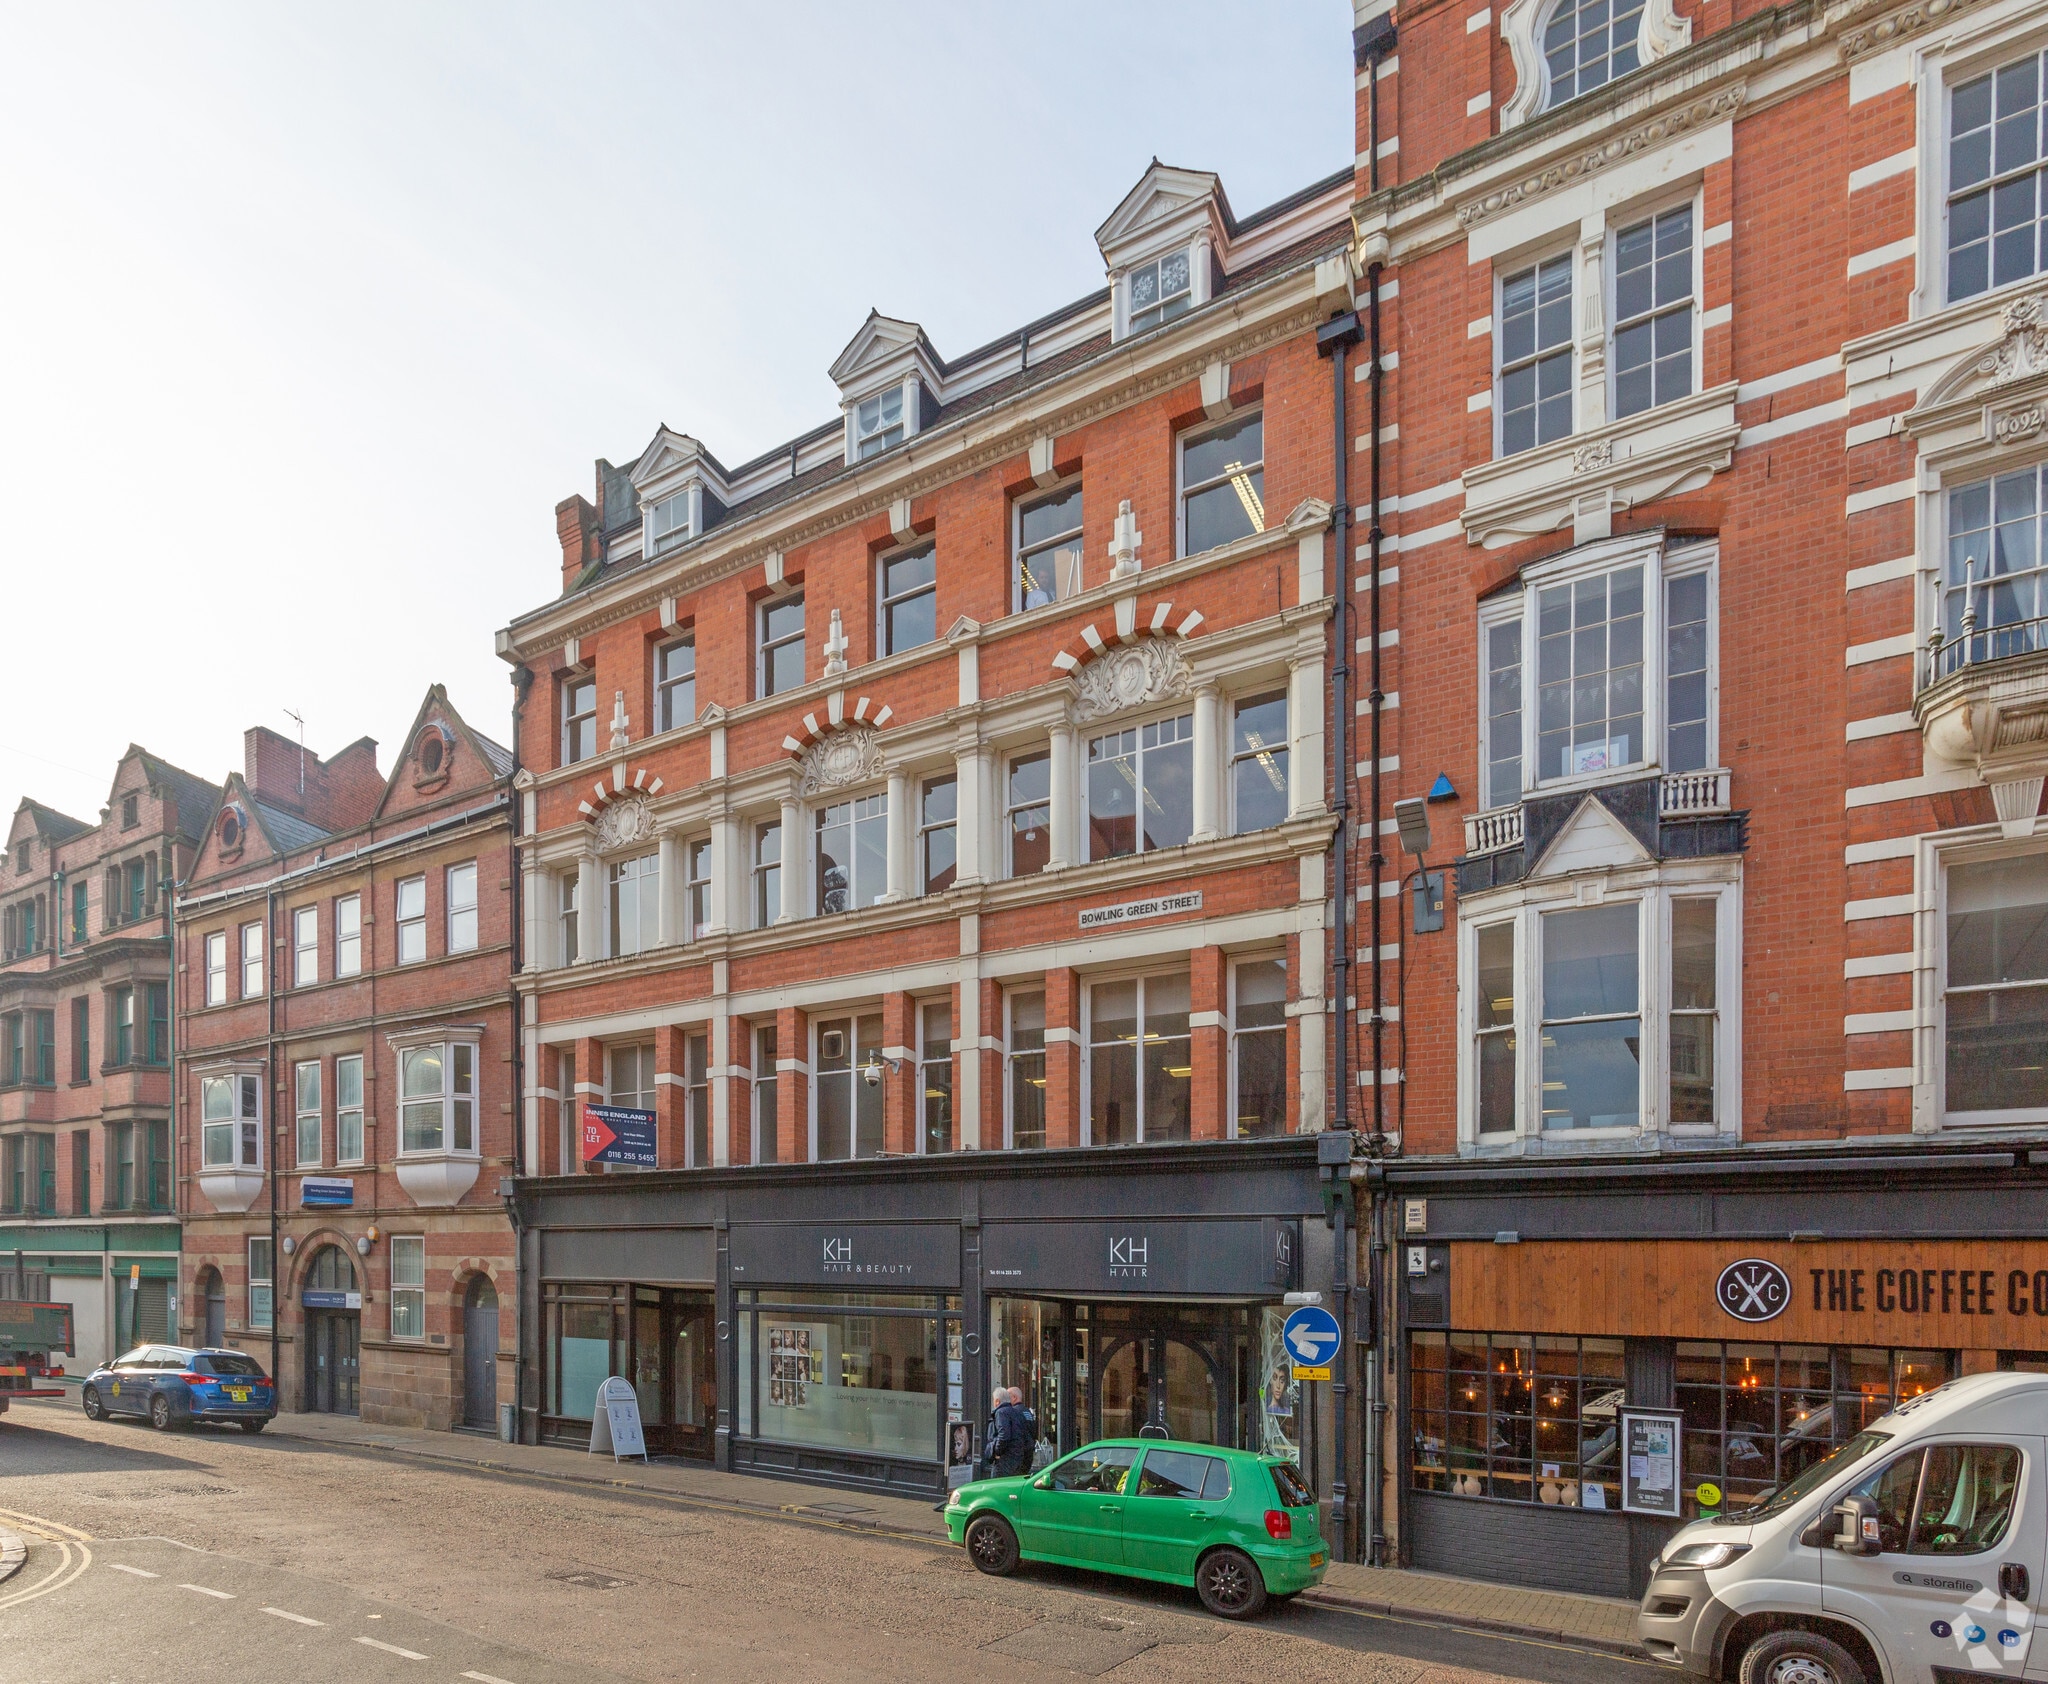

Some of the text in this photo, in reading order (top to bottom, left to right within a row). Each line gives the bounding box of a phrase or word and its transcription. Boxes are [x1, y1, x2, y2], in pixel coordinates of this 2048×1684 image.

[1081, 895, 1199, 924] BOWLING GREEN STREET
[610, 1112, 647, 1121] ENGLAND
[586, 1126, 597, 1135] TO
[586, 1135, 601, 1143] LET
[624, 1152, 636, 1160] 255
[823, 1238, 851, 1260] KH
[1110, 1237, 1147, 1263] KH
[1276, 1230, 1290, 1262] KH
[823, 1264, 912, 1273] HAIR & BEAUTY
[1110, 1268, 1148, 1277] HAIR
[1810, 1269, 1865, 1312] THE
[1876, 1269, 1995, 1315] COFFEE
[1923, 1577, 1974, 1591] storafile
